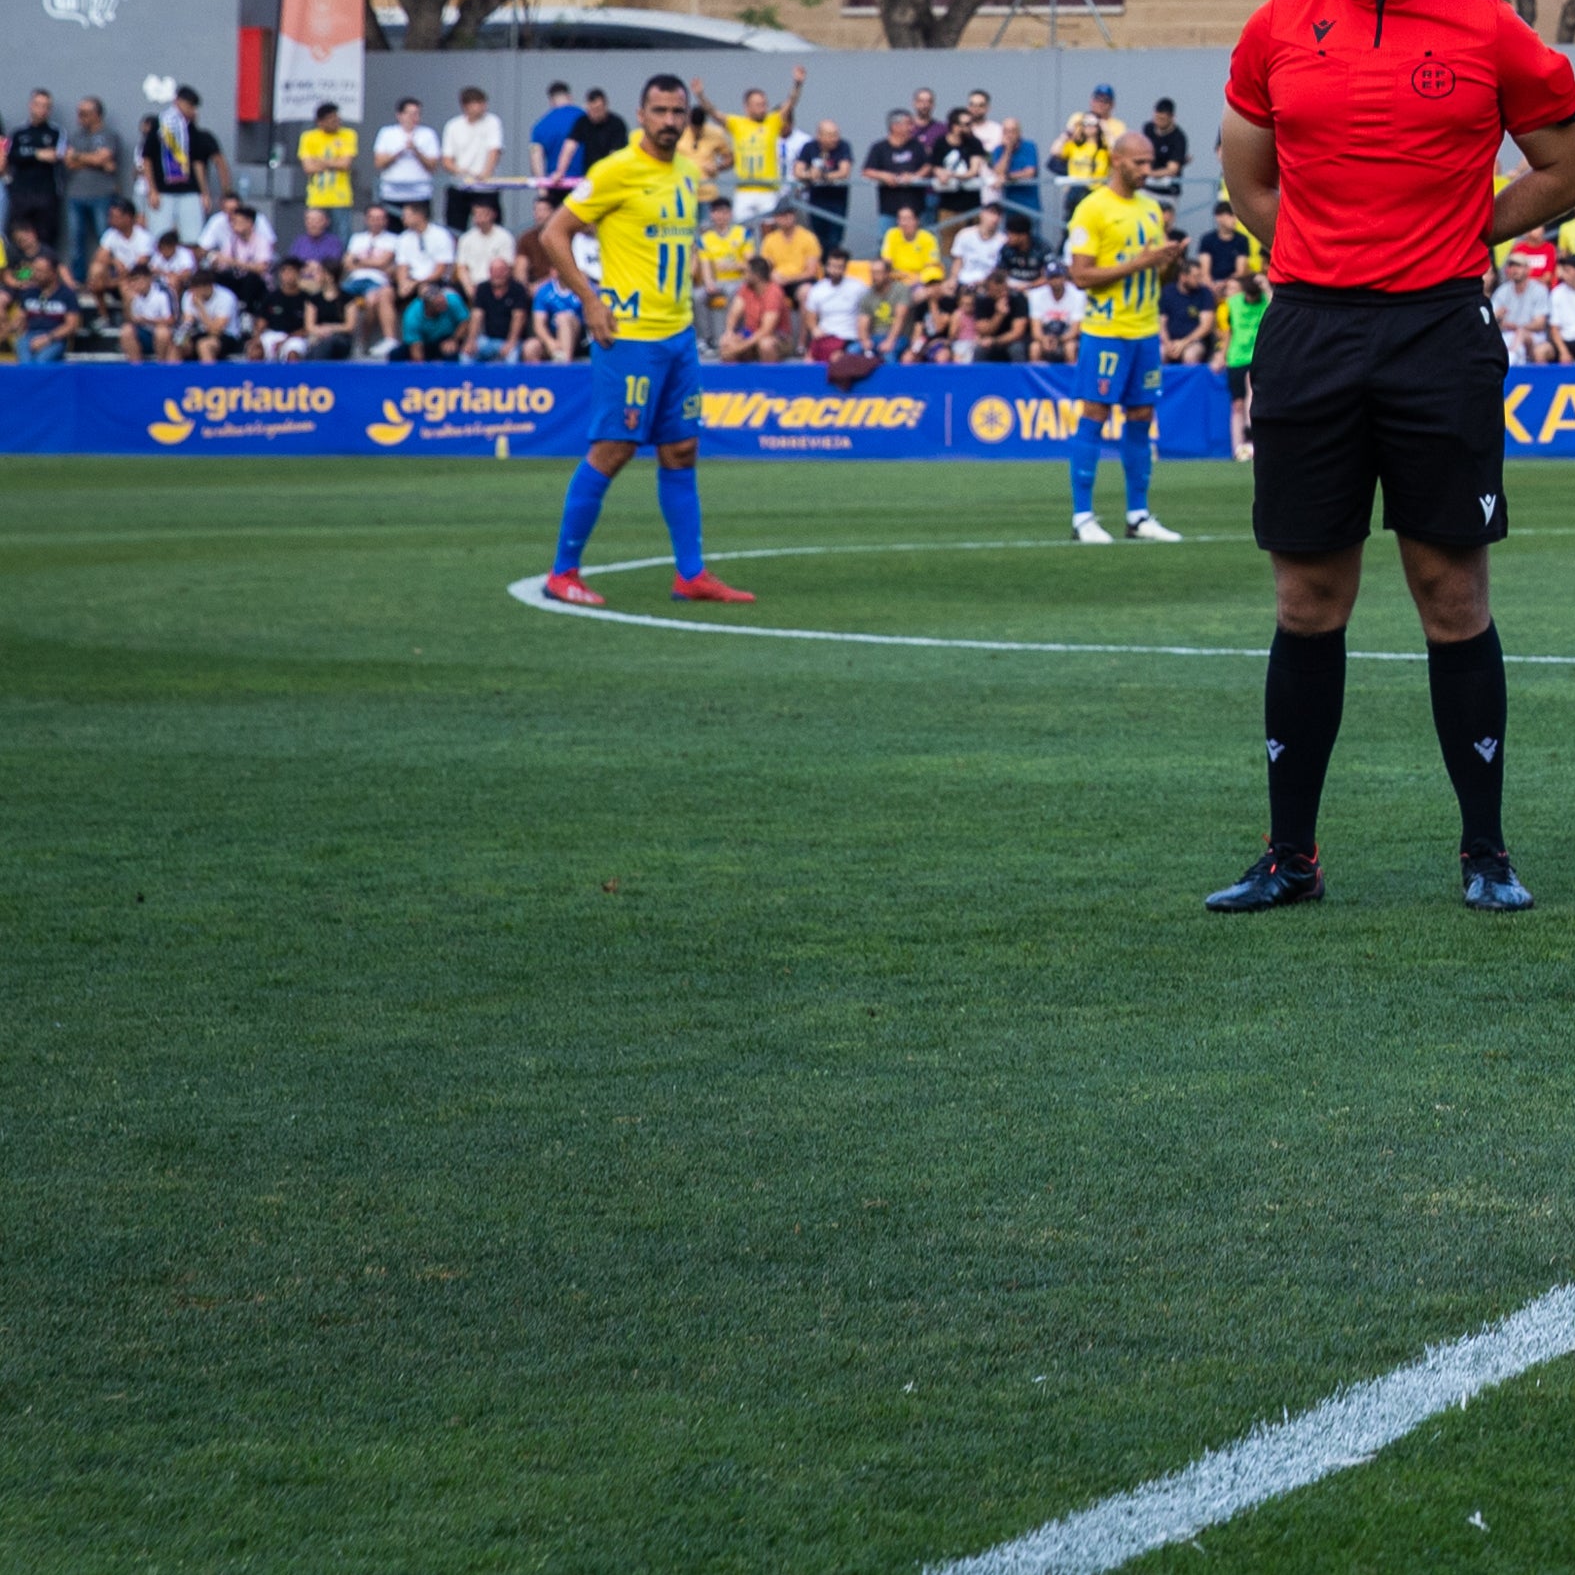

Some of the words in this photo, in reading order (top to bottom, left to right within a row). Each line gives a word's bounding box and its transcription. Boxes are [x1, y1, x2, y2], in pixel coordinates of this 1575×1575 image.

[1098, 351, 1119, 377] 17
[182, 380, 335, 422] agriauto
[401, 380, 555, 422] agriauto
[625, 375, 650, 406] 10
